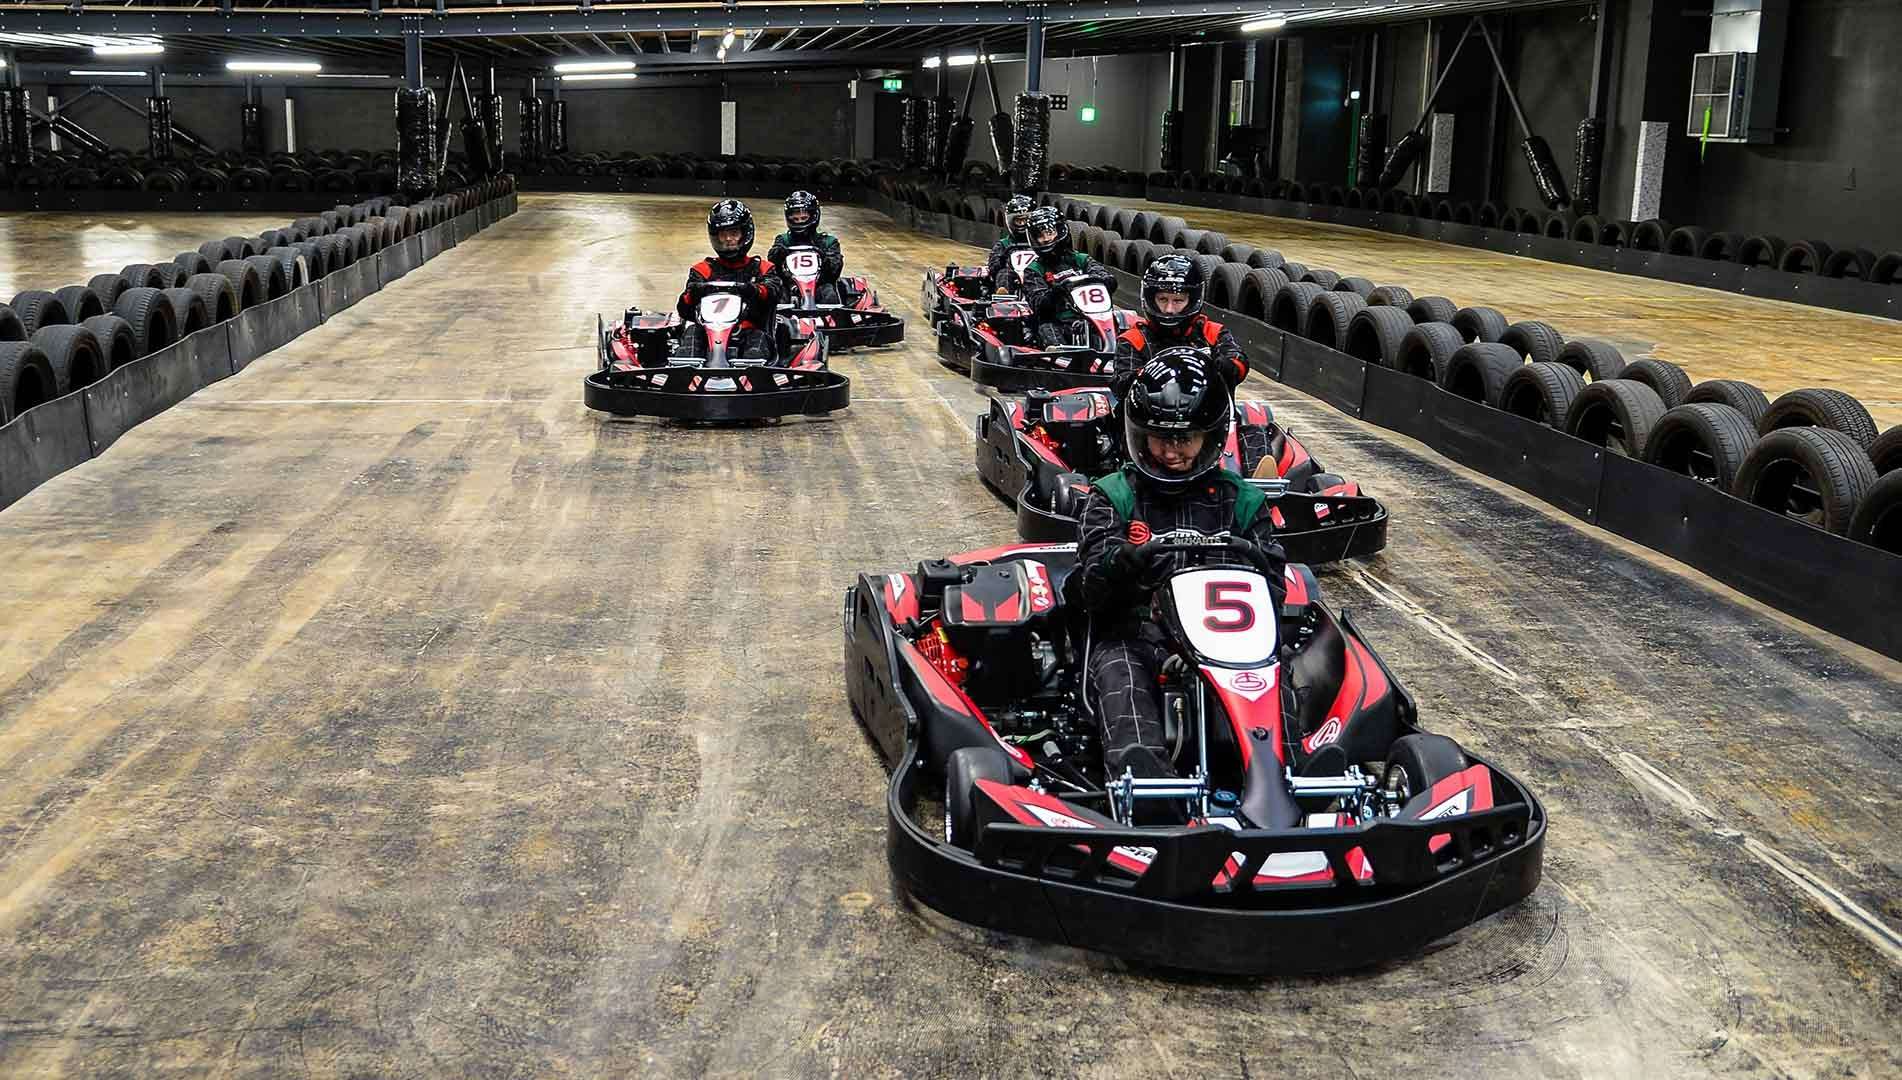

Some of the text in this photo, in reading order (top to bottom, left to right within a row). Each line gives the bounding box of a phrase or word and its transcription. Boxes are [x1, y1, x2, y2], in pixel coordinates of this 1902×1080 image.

[791, 255, 813, 270] 15
[1016, 253, 1034, 266] 17
[1079, 288, 1105, 306] 18
[1147, 420, 1191, 429] LS2
[1203, 581, 1255, 632] 5
